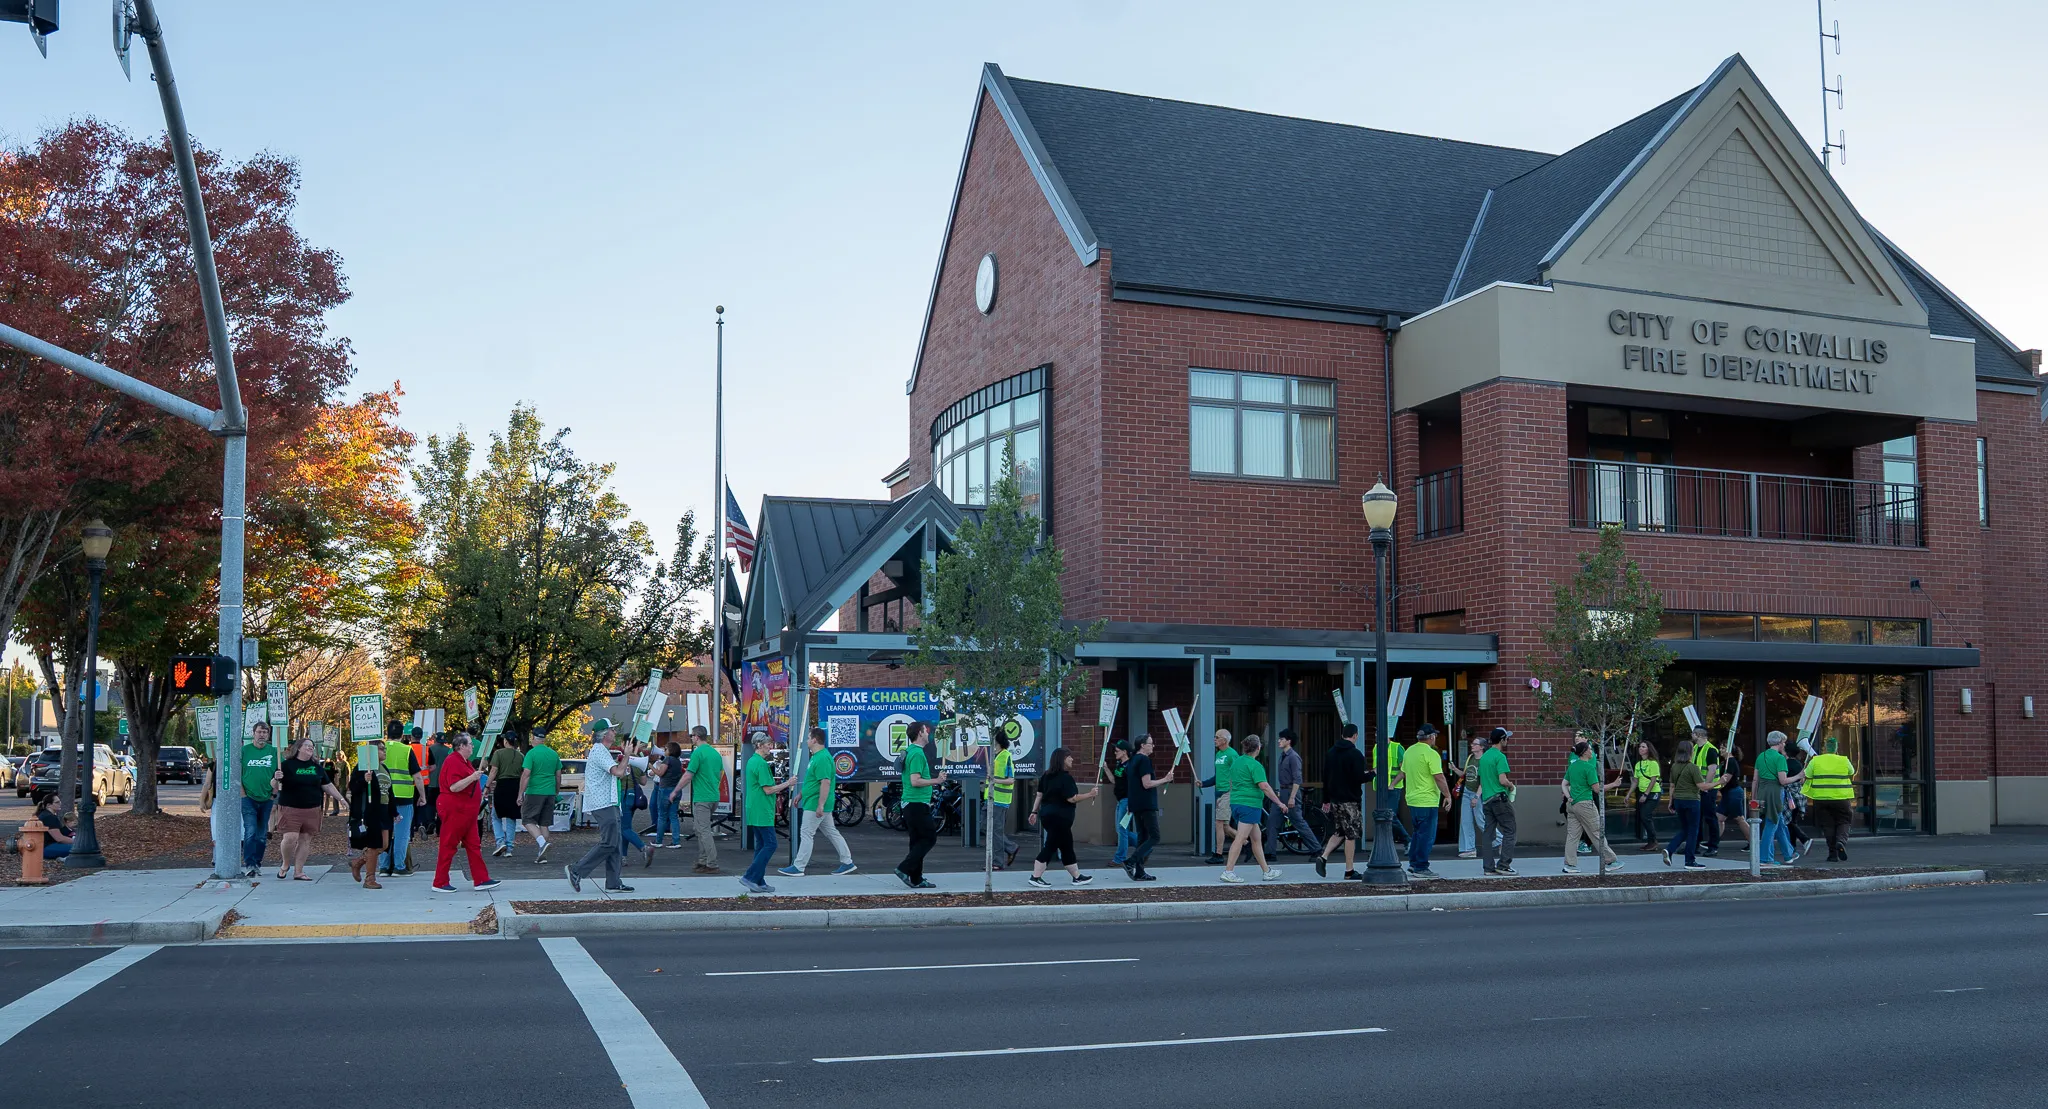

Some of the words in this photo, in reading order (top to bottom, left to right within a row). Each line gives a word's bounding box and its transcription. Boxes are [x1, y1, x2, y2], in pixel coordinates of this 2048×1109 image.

[1609, 309, 1674, 340] CITY
[1692, 319, 1729, 345] OF
[1744, 325, 1888, 364] CORVALLIS
[1624, 345, 1688, 375] FIRE
[1703, 353, 1878, 394] DEPARTMENT
[833, 691, 868, 703] TAKE
[871, 691, 926, 703] CHARGE
